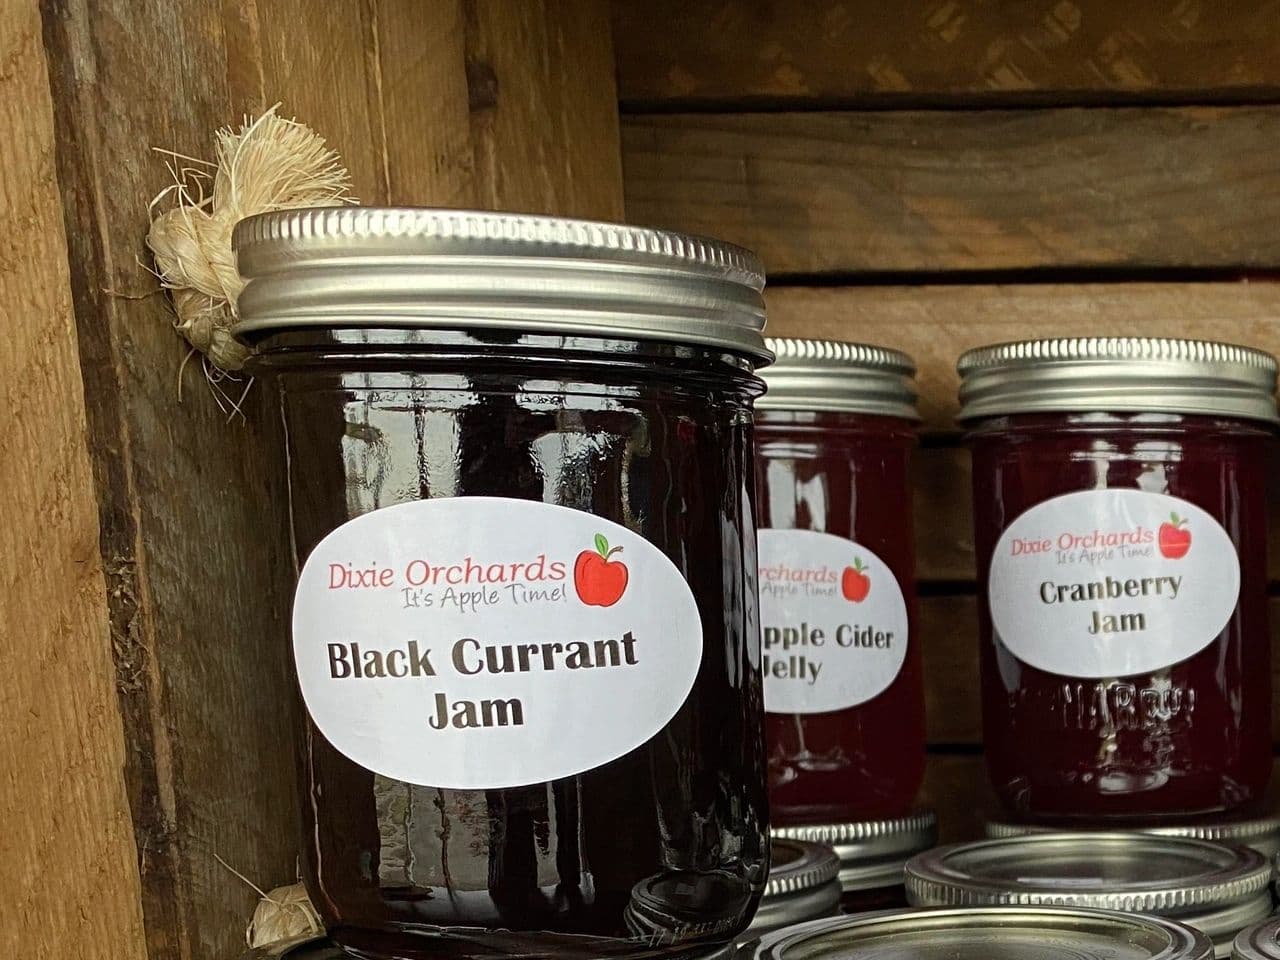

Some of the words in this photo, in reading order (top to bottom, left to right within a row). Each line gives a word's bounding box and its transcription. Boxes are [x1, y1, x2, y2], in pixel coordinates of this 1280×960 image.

[1010, 538, 1052, 556] Dixie
[1058, 526, 1154, 550] Orchards
[328, 562, 394, 590] Dixie
[405, 555, 566, 587] Orchards
[759, 564, 838, 583] rchards
[402, 587, 433, 609] It's
[441, 585, 500, 613] Apple
[505, 583, 567, 603] Time!
[1040, 575, 1182, 604] Cranberry
[764, 622, 825, 650] pple
[836, 624, 894, 649] Cider
[1088, 610, 1146, 634] Jam
[327, 640, 437, 679] Black
[451, 631, 640, 676] Currant
[429, 693, 524, 730] Jam
